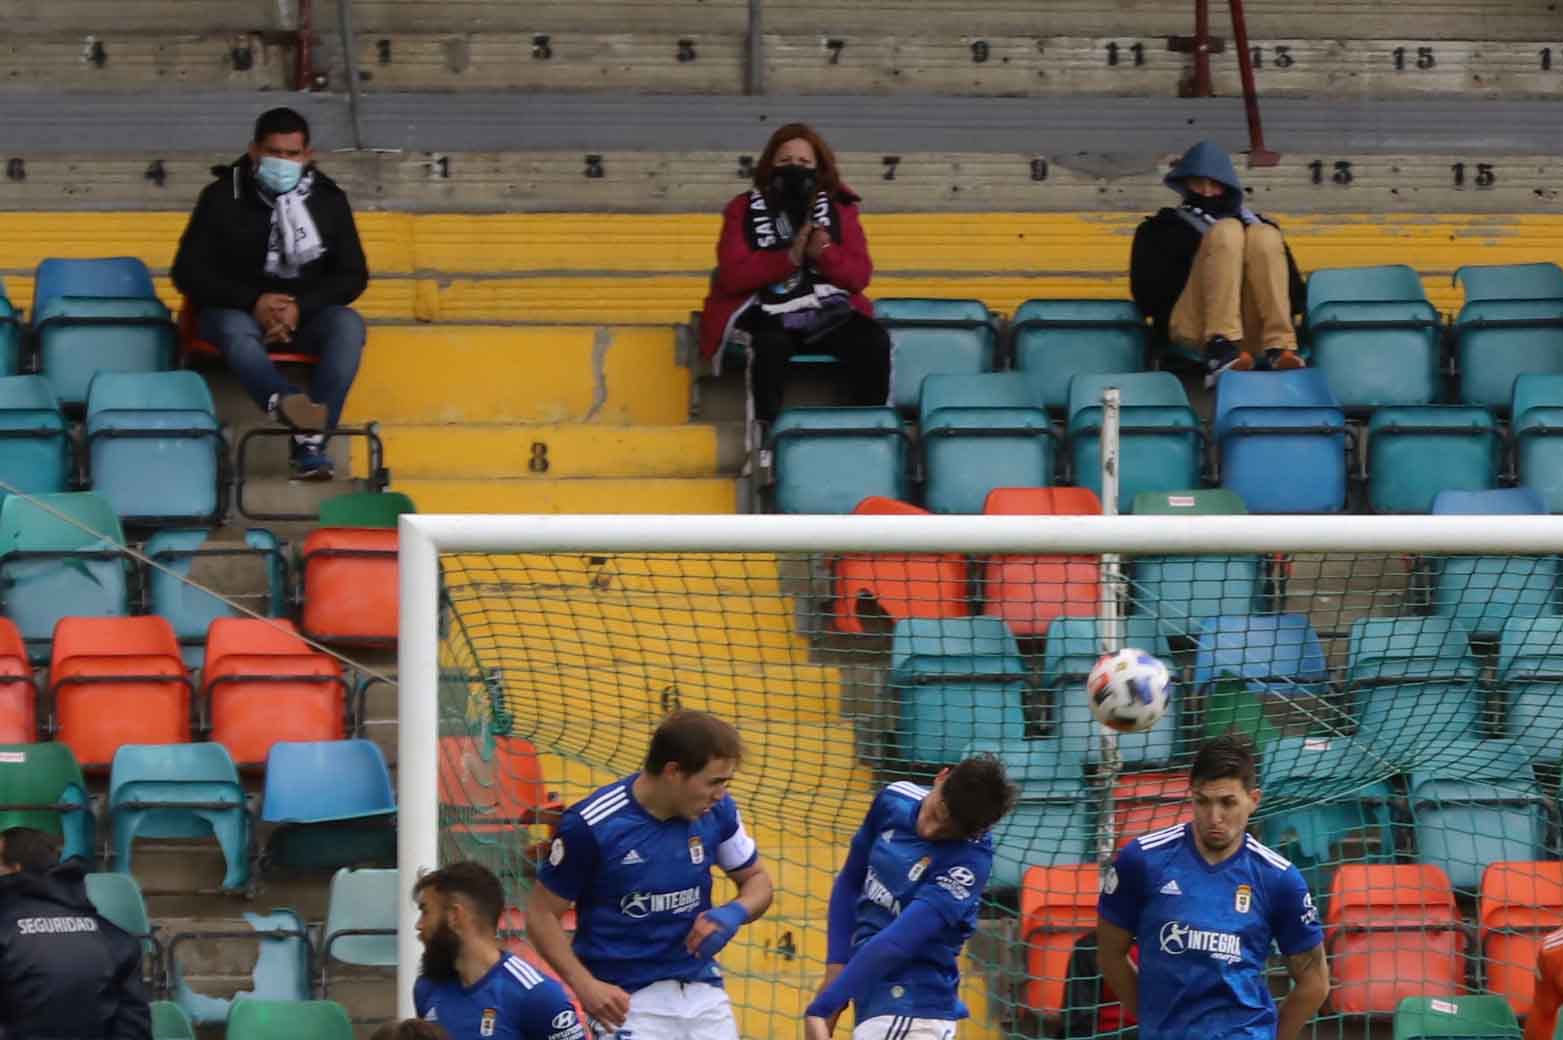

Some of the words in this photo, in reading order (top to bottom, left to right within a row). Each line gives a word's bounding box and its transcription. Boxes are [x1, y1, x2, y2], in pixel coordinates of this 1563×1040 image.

[826, 40, 845, 64] 7
[1106, 42, 1144, 66] 11
[1392, 47, 1435, 70] 15
[881, 156, 899, 181] 7
[1307, 160, 1353, 185] 13
[1450, 163, 1496, 190] 15
[528, 441, 549, 473] 8
[17, 915, 98, 936] SEGURIDAD
